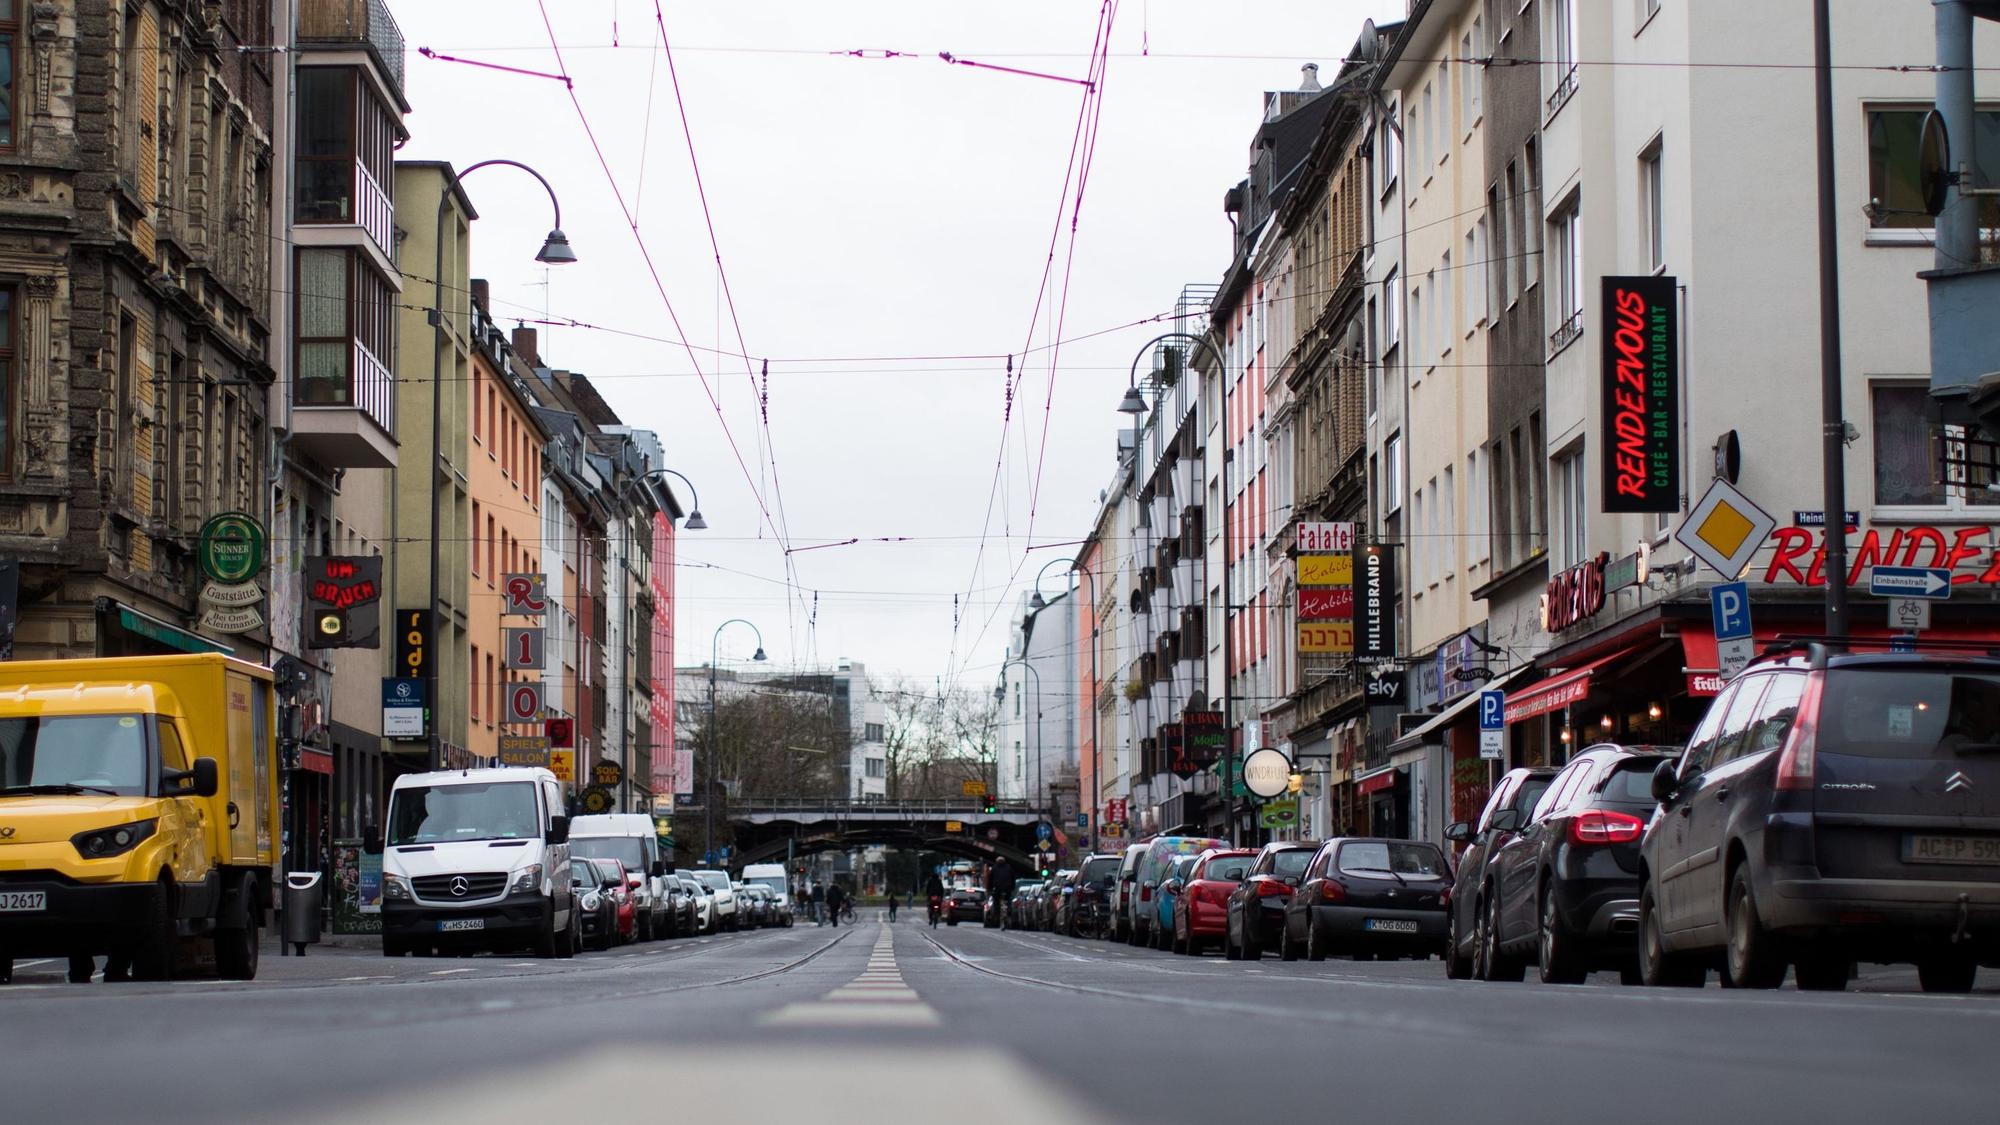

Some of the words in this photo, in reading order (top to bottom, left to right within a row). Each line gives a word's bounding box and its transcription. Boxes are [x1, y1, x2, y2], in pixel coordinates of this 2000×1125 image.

[1652, 305, 1667, 397] RESTAURANT
[1615, 288, 1646, 498] RENDEZVOUS
[1653, 411, 1668, 438] BAR
[1651, 451, 1668, 487] CAFÉ
[1299, 523, 1354, 549] Falafel
[1300, 558, 1352, 583] Habibi
[1875, 577, 1928, 586] Einbahnstraße
[206, 586, 256, 601] Gaststätte
[1300, 591, 1353, 616] Habibi
[1368, 555, 1380, 650] HILLEBRAND
[213, 612, 226, 621] Bei
[229, 613, 249, 622] Oma
[1720, 590, 1740, 632] P
[205, 618, 257, 630] Kleinmann
[1301, 629, 1353, 646] ברכה
[1368, 679, 1399, 698] sky
[1484, 696, 1497, 725] P
[504, 753, 544, 763] SALON
[596, 767, 620, 775] SOUL
[1919, 838, 1941, 857] AC
[1954, 839, 1966, 856] P
[11, 894, 44, 909] 2617
